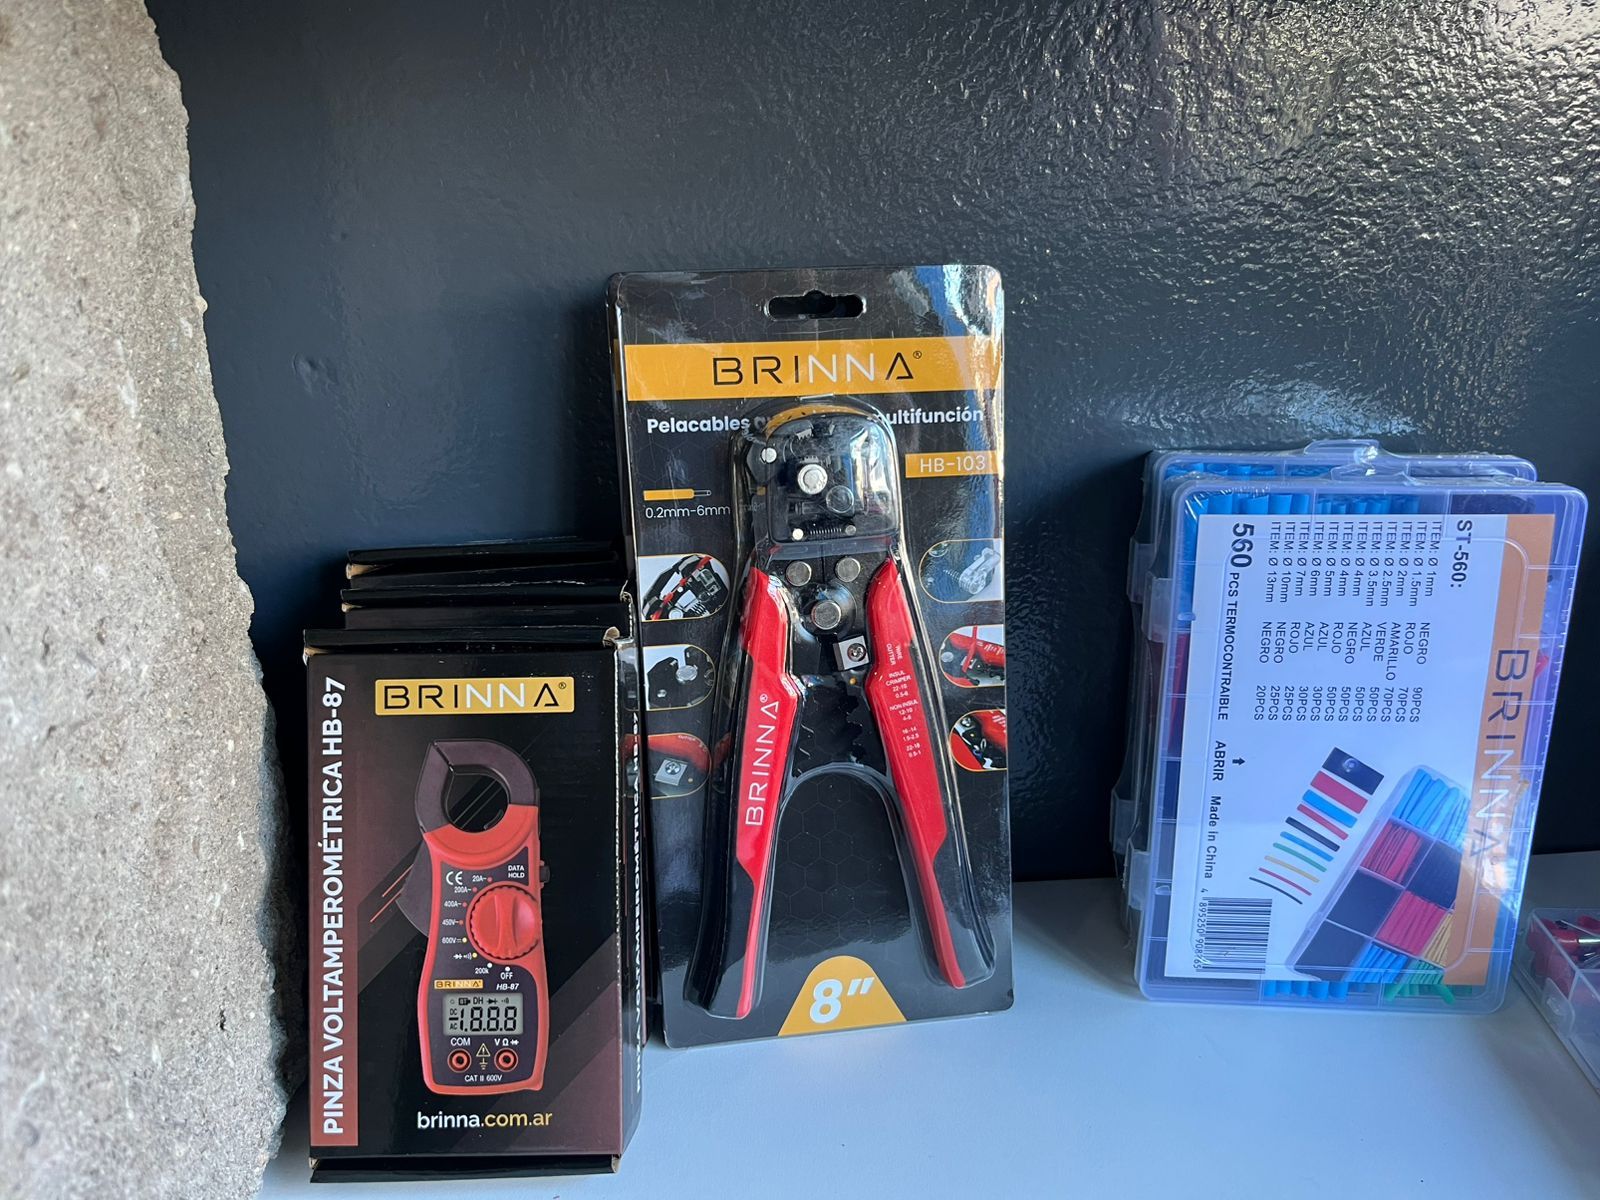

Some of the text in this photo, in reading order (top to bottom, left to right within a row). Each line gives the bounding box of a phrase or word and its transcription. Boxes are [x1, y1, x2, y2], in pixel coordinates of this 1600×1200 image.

[647, 416, 750, 434] Pelacables
[919, 455, 986, 473] HB-103
[645, 505, 731, 519] 0.2mm-6mm
[1269, 522, 1281, 553] ITEM:
[1283, 522, 1296, 553] ITEM:
[1298, 522, 1311, 553] ITEM:
[1312, 522, 1324, 553] ITEM:
[1327, 522, 1339, 553] ITEM:
[1342, 522, 1354, 553] ITEM:
[1356, 522, 1368, 553] ITEM:
[1371, 522, 1383, 553] ITEM:
[1385, 522, 1398, 553] ITEM:
[1399, 522, 1412, 553] ITEM:
[1415, 522, 1427, 553] ITEM:
[1429, 522, 1443, 553] ITEM:
[1449, 519, 1472, 588] ST-560:
[1265, 570, 1277, 602] 13mm
[1280, 570, 1292, 602] 10mm
[1294, 570, 1306, 596] 7mm
[1309, 570, 1320, 596] 6mm
[1323, 570, 1333, 596] 5mm
[1337, 570, 1348, 596] 4mm
[1352, 570, 1362, 596] 4mm
[1365, 570, 1378, 606] 3.5mm
[1380, 570, 1393, 606] 2.5mm
[1396, 570, 1408, 596] 2mm
[1409, 570, 1422, 606] 1.5mm
[1425, 570, 1436, 596] 1mm
[1218, 523, 1254, 720] 560 PCS TERMOCONTRAIBLE
[1303, 622, 1315, 651] AZUL
[1317, 622, 1329, 651] AZUL
[1360, 622, 1372, 651] AZUL
[1259, 622, 1272, 664] NEGRO
[1274, 622, 1287, 664] NEGRO
[1288, 622, 1301, 654] ROJO
[1331, 622, 1344, 654] ROJO
[1344, 622, 1358, 664] NEGRO
[1373, 622, 1387, 662] VERDE
[1386, 622, 1402, 680] AMARILLO
[1403, 622, 1416, 655] ROJO
[1417, 622, 1430, 664] NEGRO
[1254, 685, 1267, 720] 20PCS
[1268, 685, 1281, 720] 25PCS
[1282, 685, 1295, 721] 25PCS
[1296, 686, 1309, 721] 30PCS
[1310, 686, 1323, 721] 30PCS
[1324, 686, 1337, 721] 50PCS
[1338, 686, 1352, 722] 50PCS
[1352, 686, 1366, 722] 50PCS
[1366, 686, 1380, 722] 50PCS
[1381, 686, 1394, 722] 70PCS
[1395, 686, 1408, 722] 70PCS
[1409, 686, 1422, 723] 90PCS
[1213, 740, 1226, 782] ABRIR
[1204, 796, 1221, 879] Made in China
[317, 677, 346, 1134] PINZA VOLTAMPEROMÉTRICA HB-87
[496, 983, 520, 991] HB-87
[500, 972, 514, 980] OFF
[473, 997, 484, 1005] DH
[450, 1037, 471, 1047] COM
[464, 1074, 478, 1082] CAT
[486, 1074, 503, 1082] 600V
[416, 1110, 553, 1131] brinna.com.ar
